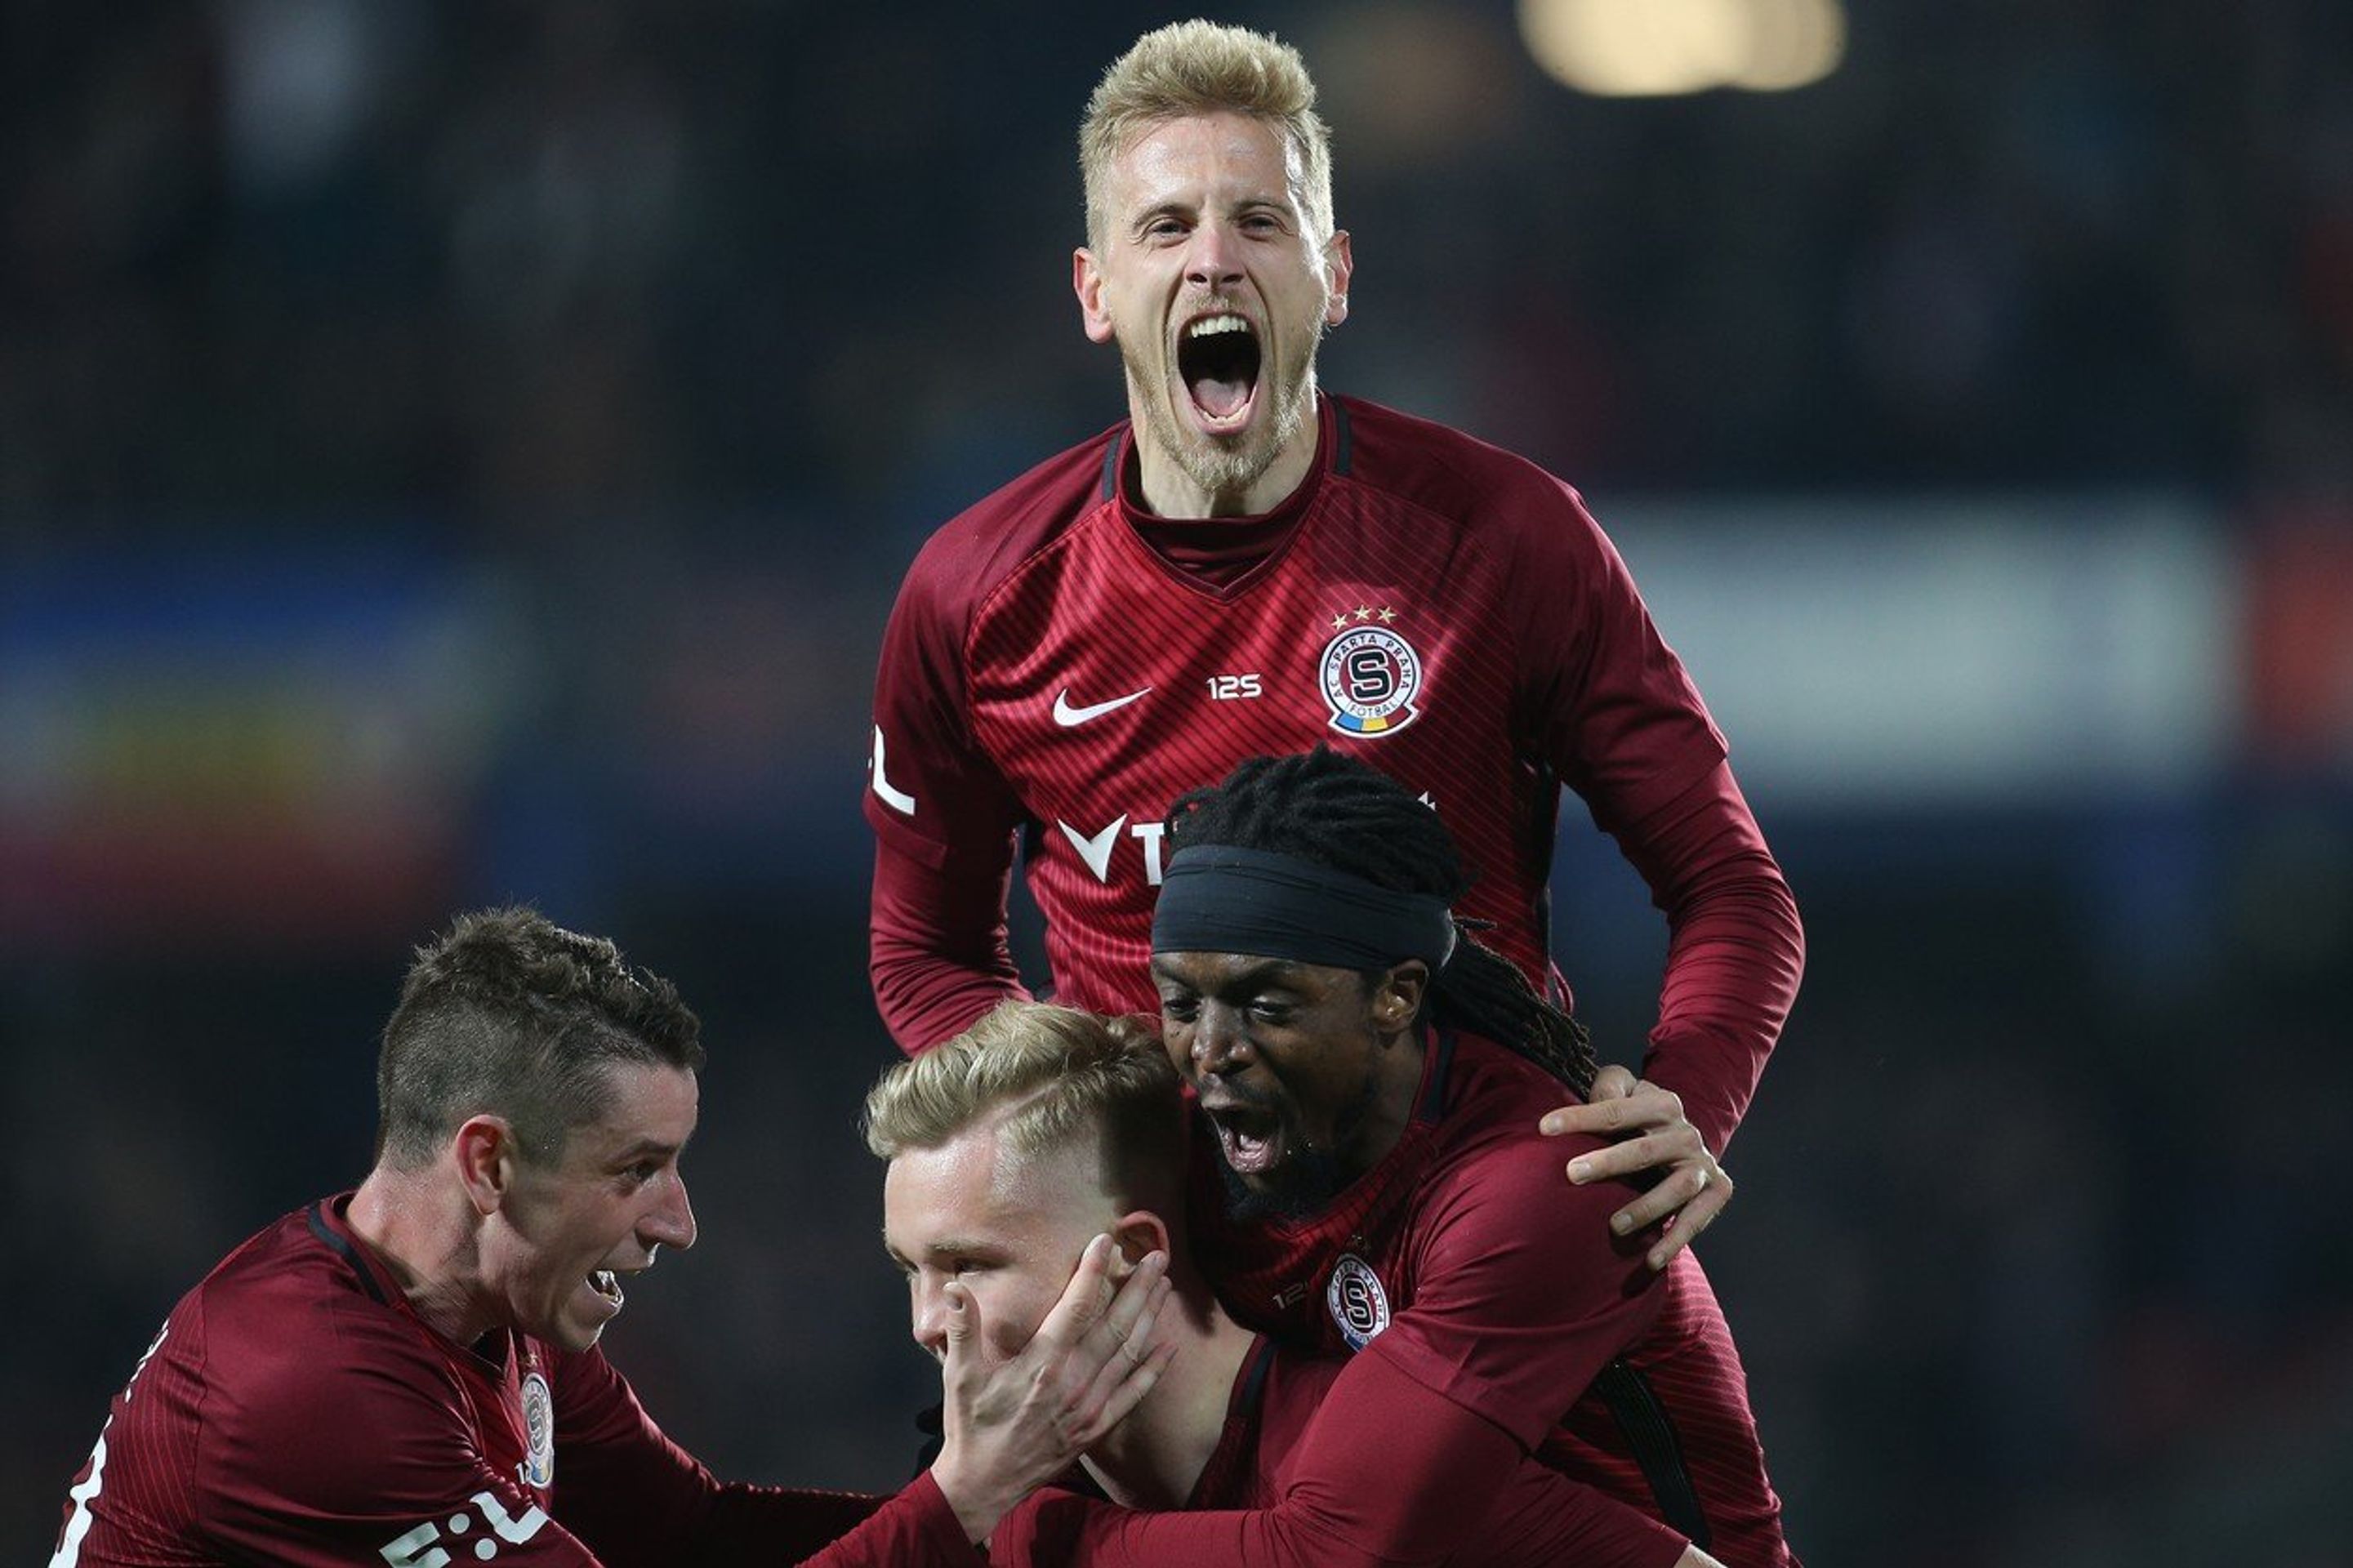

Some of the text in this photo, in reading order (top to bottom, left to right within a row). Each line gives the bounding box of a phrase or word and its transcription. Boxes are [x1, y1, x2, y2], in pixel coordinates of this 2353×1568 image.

[1329, 635, 1378, 670] SPARTA
[1386, 639, 1411, 689] PRAHA
[1349, 650, 1392, 699] S
